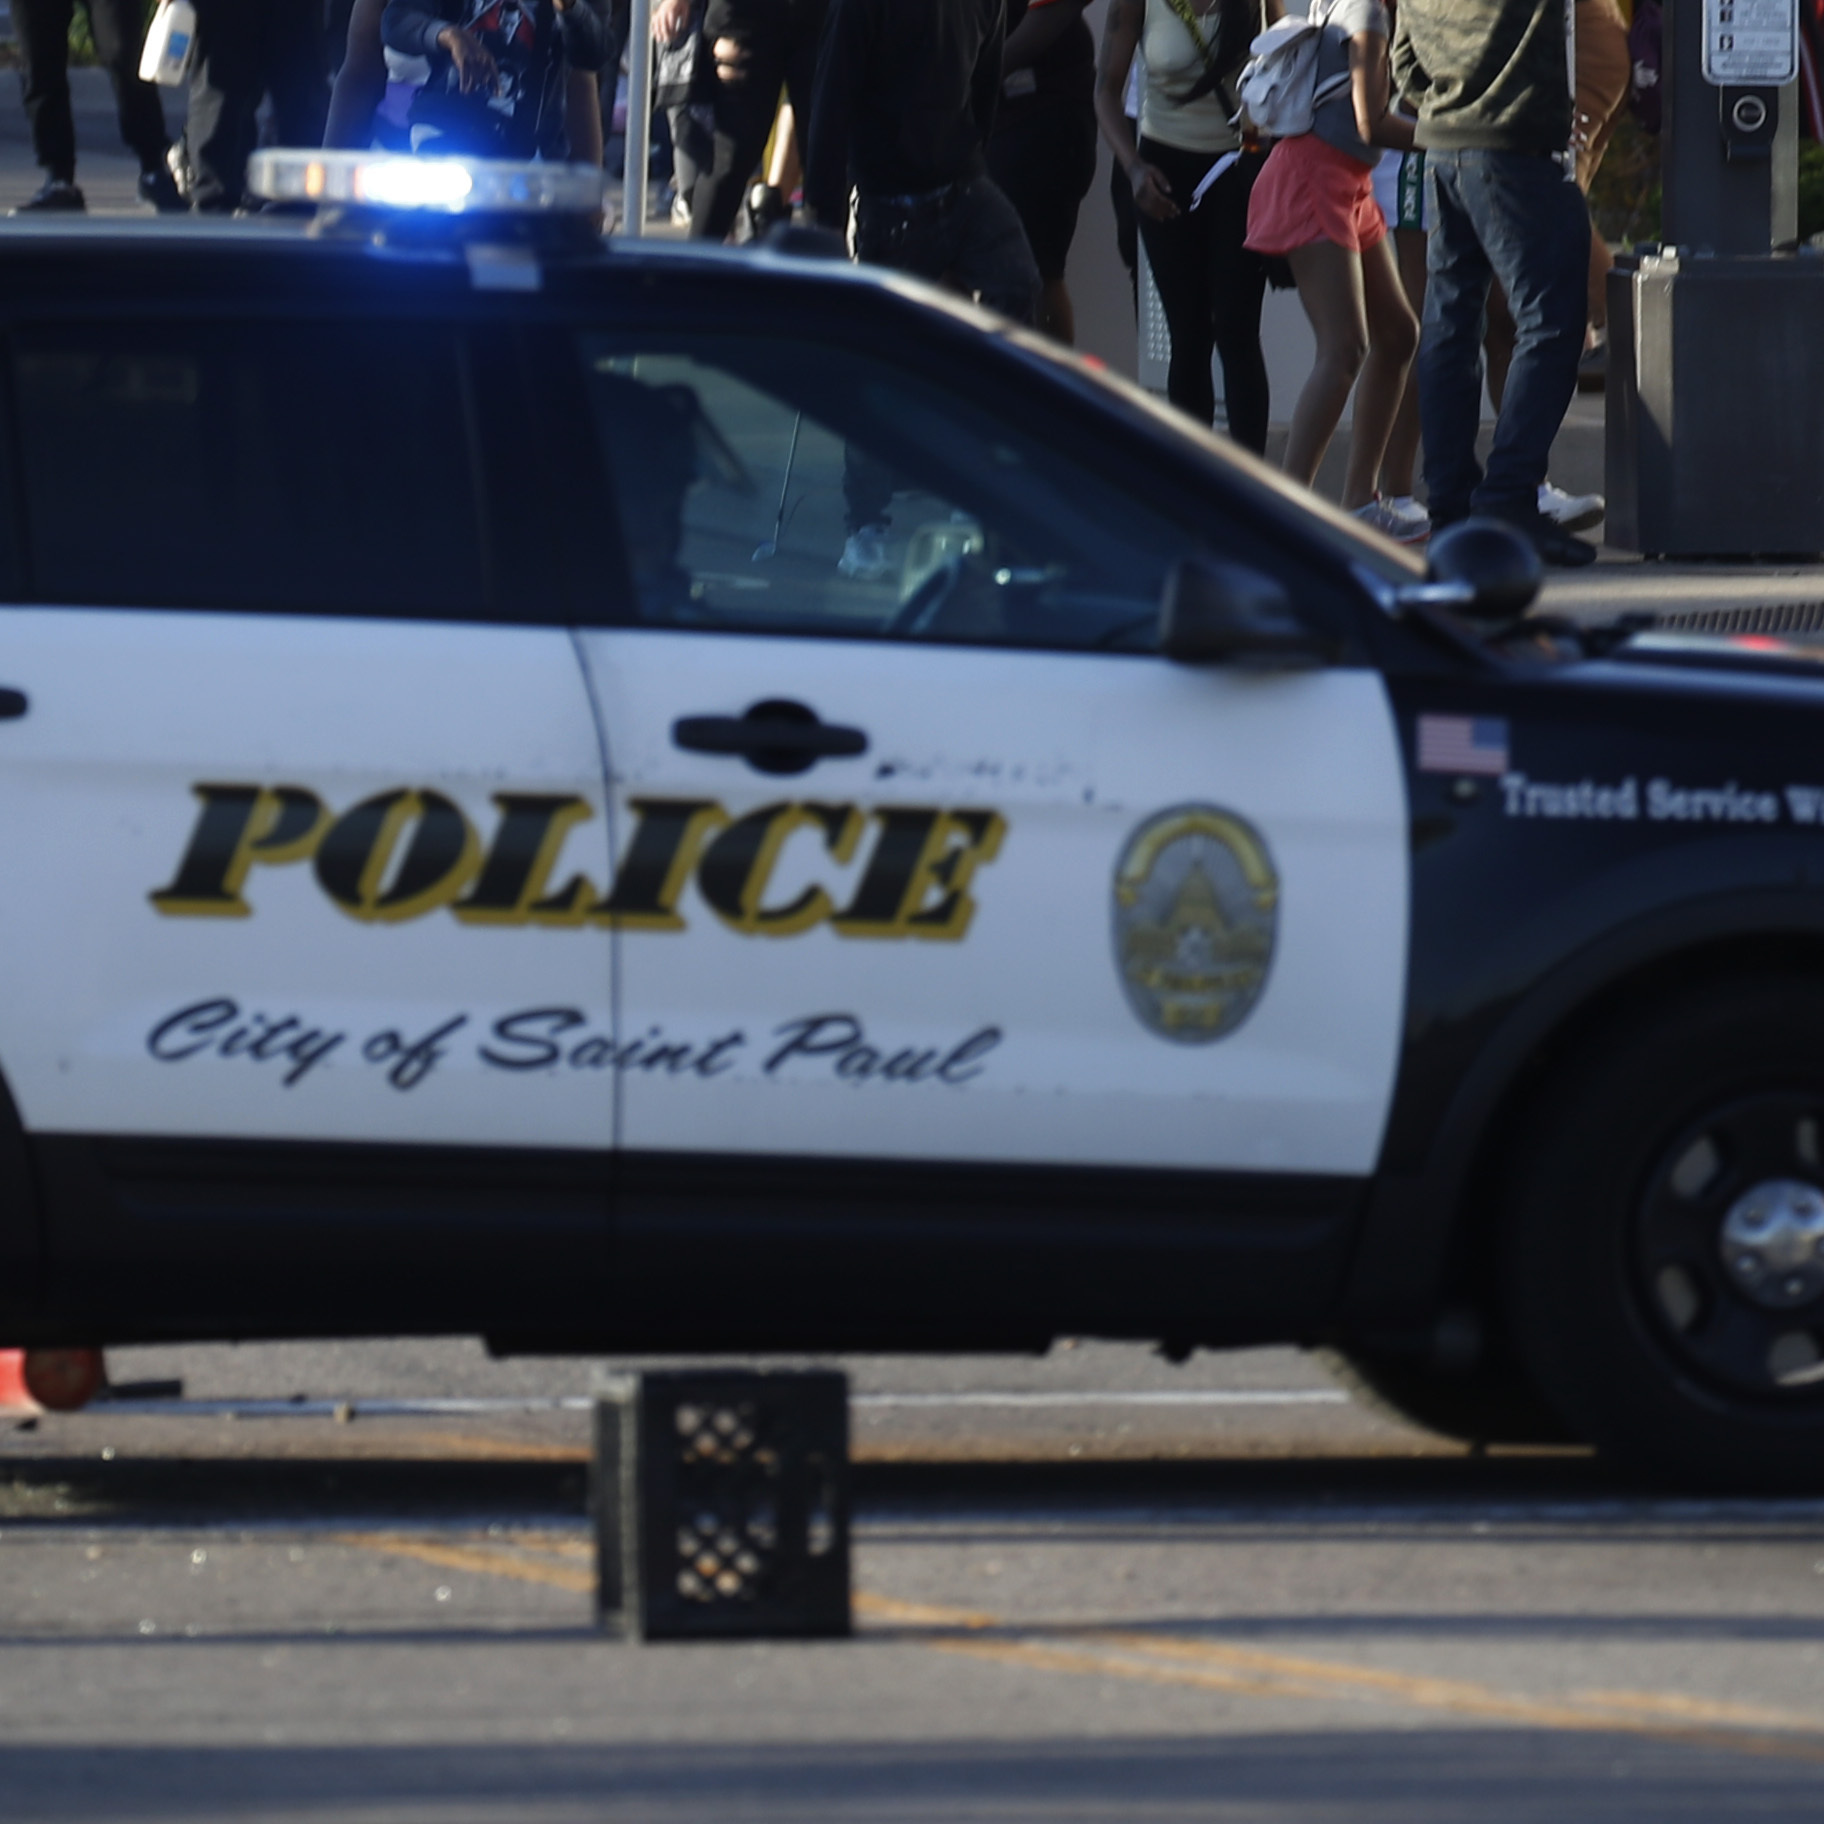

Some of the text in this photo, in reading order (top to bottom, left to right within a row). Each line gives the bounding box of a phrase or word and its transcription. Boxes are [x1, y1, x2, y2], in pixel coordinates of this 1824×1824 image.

[1501, 772, 1639, 819] Trusted
[1645, 777, 1780, 823] Service
[147, 784, 1008, 939] POLICE
[146, 999, 1002, 1090] City of Saint Paul
